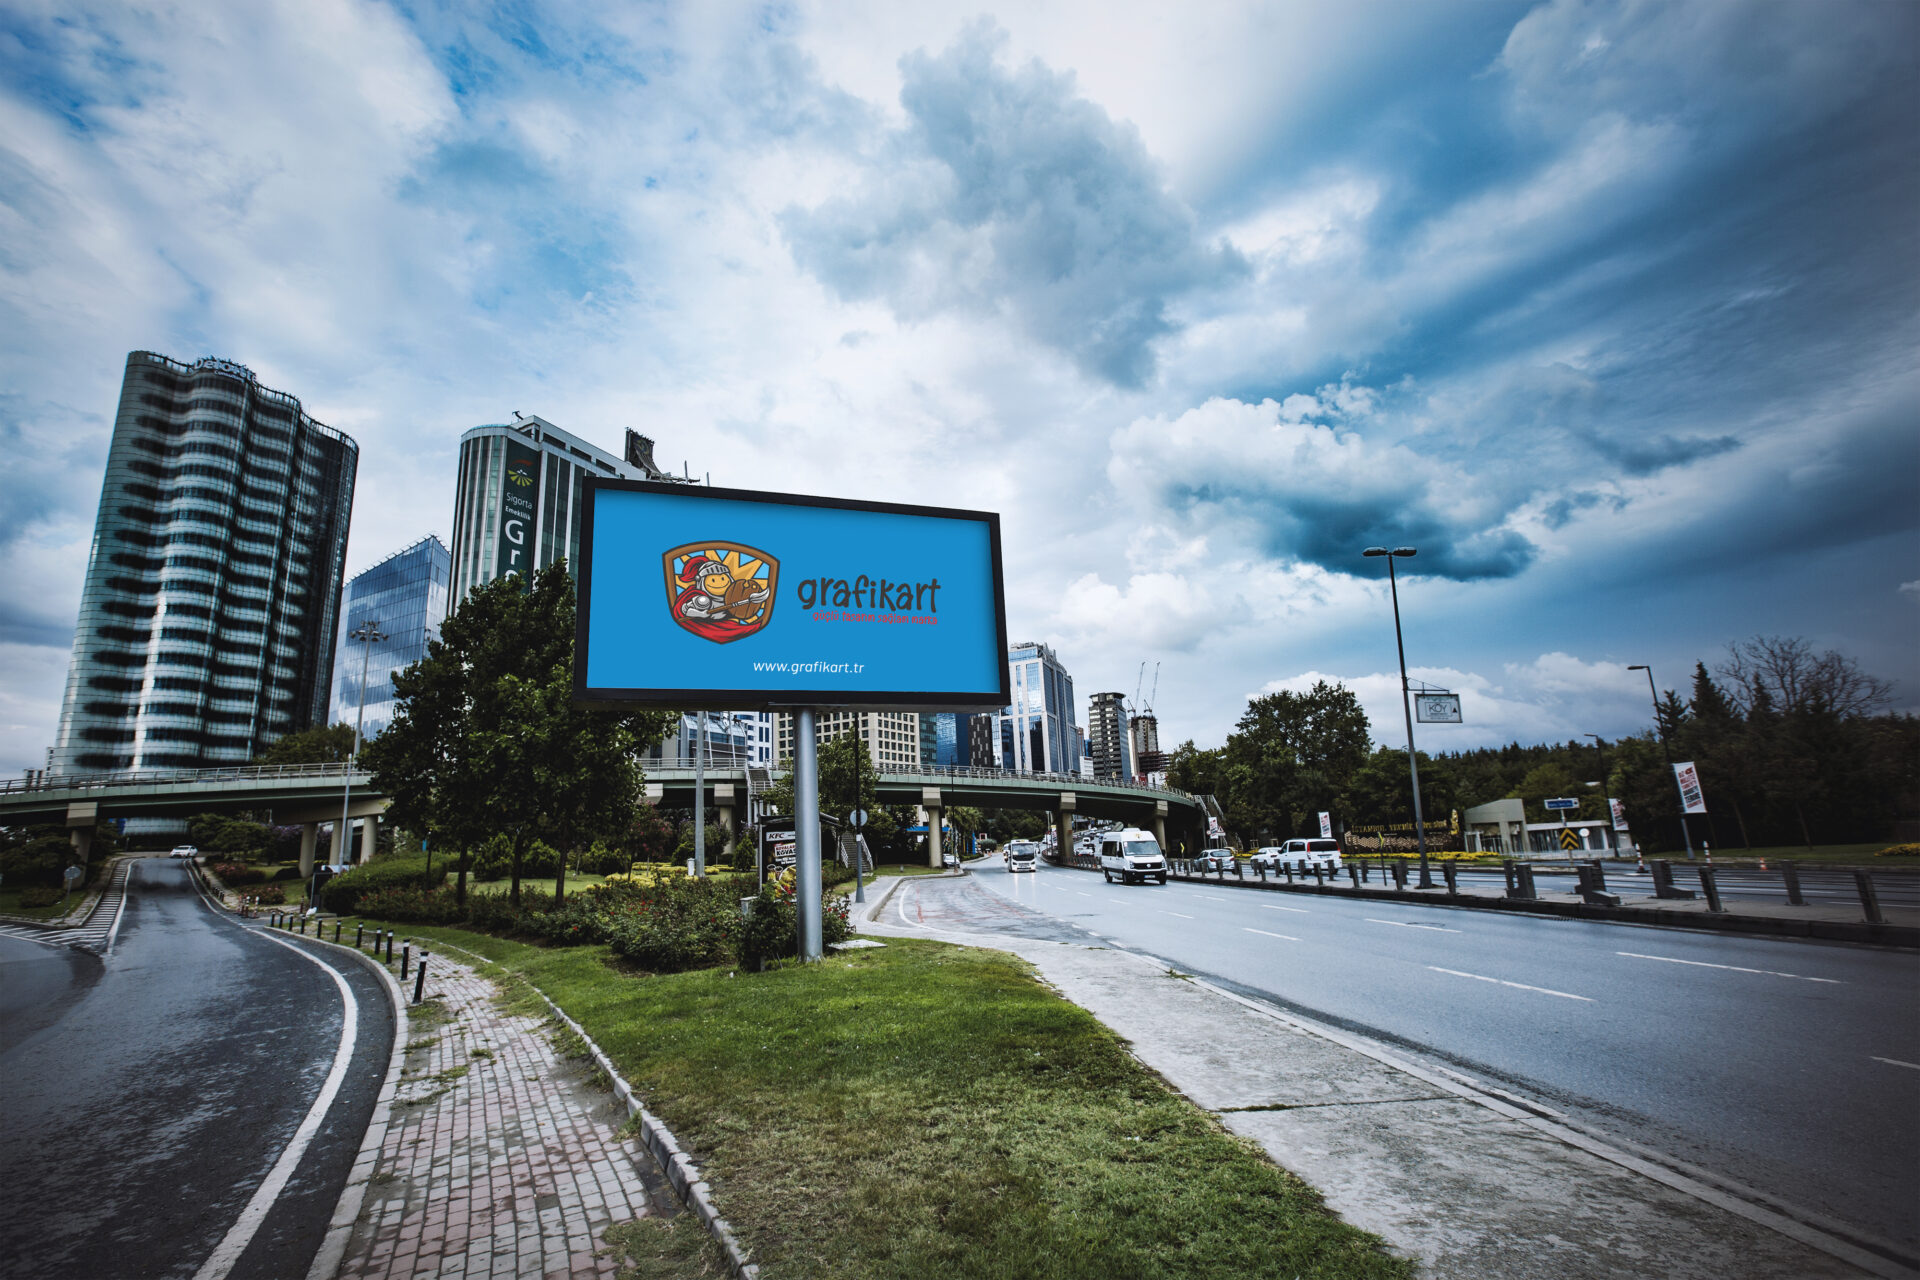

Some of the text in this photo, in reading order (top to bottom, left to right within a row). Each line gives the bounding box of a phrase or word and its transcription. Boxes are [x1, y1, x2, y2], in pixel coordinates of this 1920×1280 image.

[506, 492, 533, 510] Sigorta
[505, 506, 531, 521] Emeklilik
[797, 574, 941, 613] grafikart
[812, 610, 938, 625] güçlü tasarım sağlam marka
[753, 661, 865, 675] www.grafikart.tr
